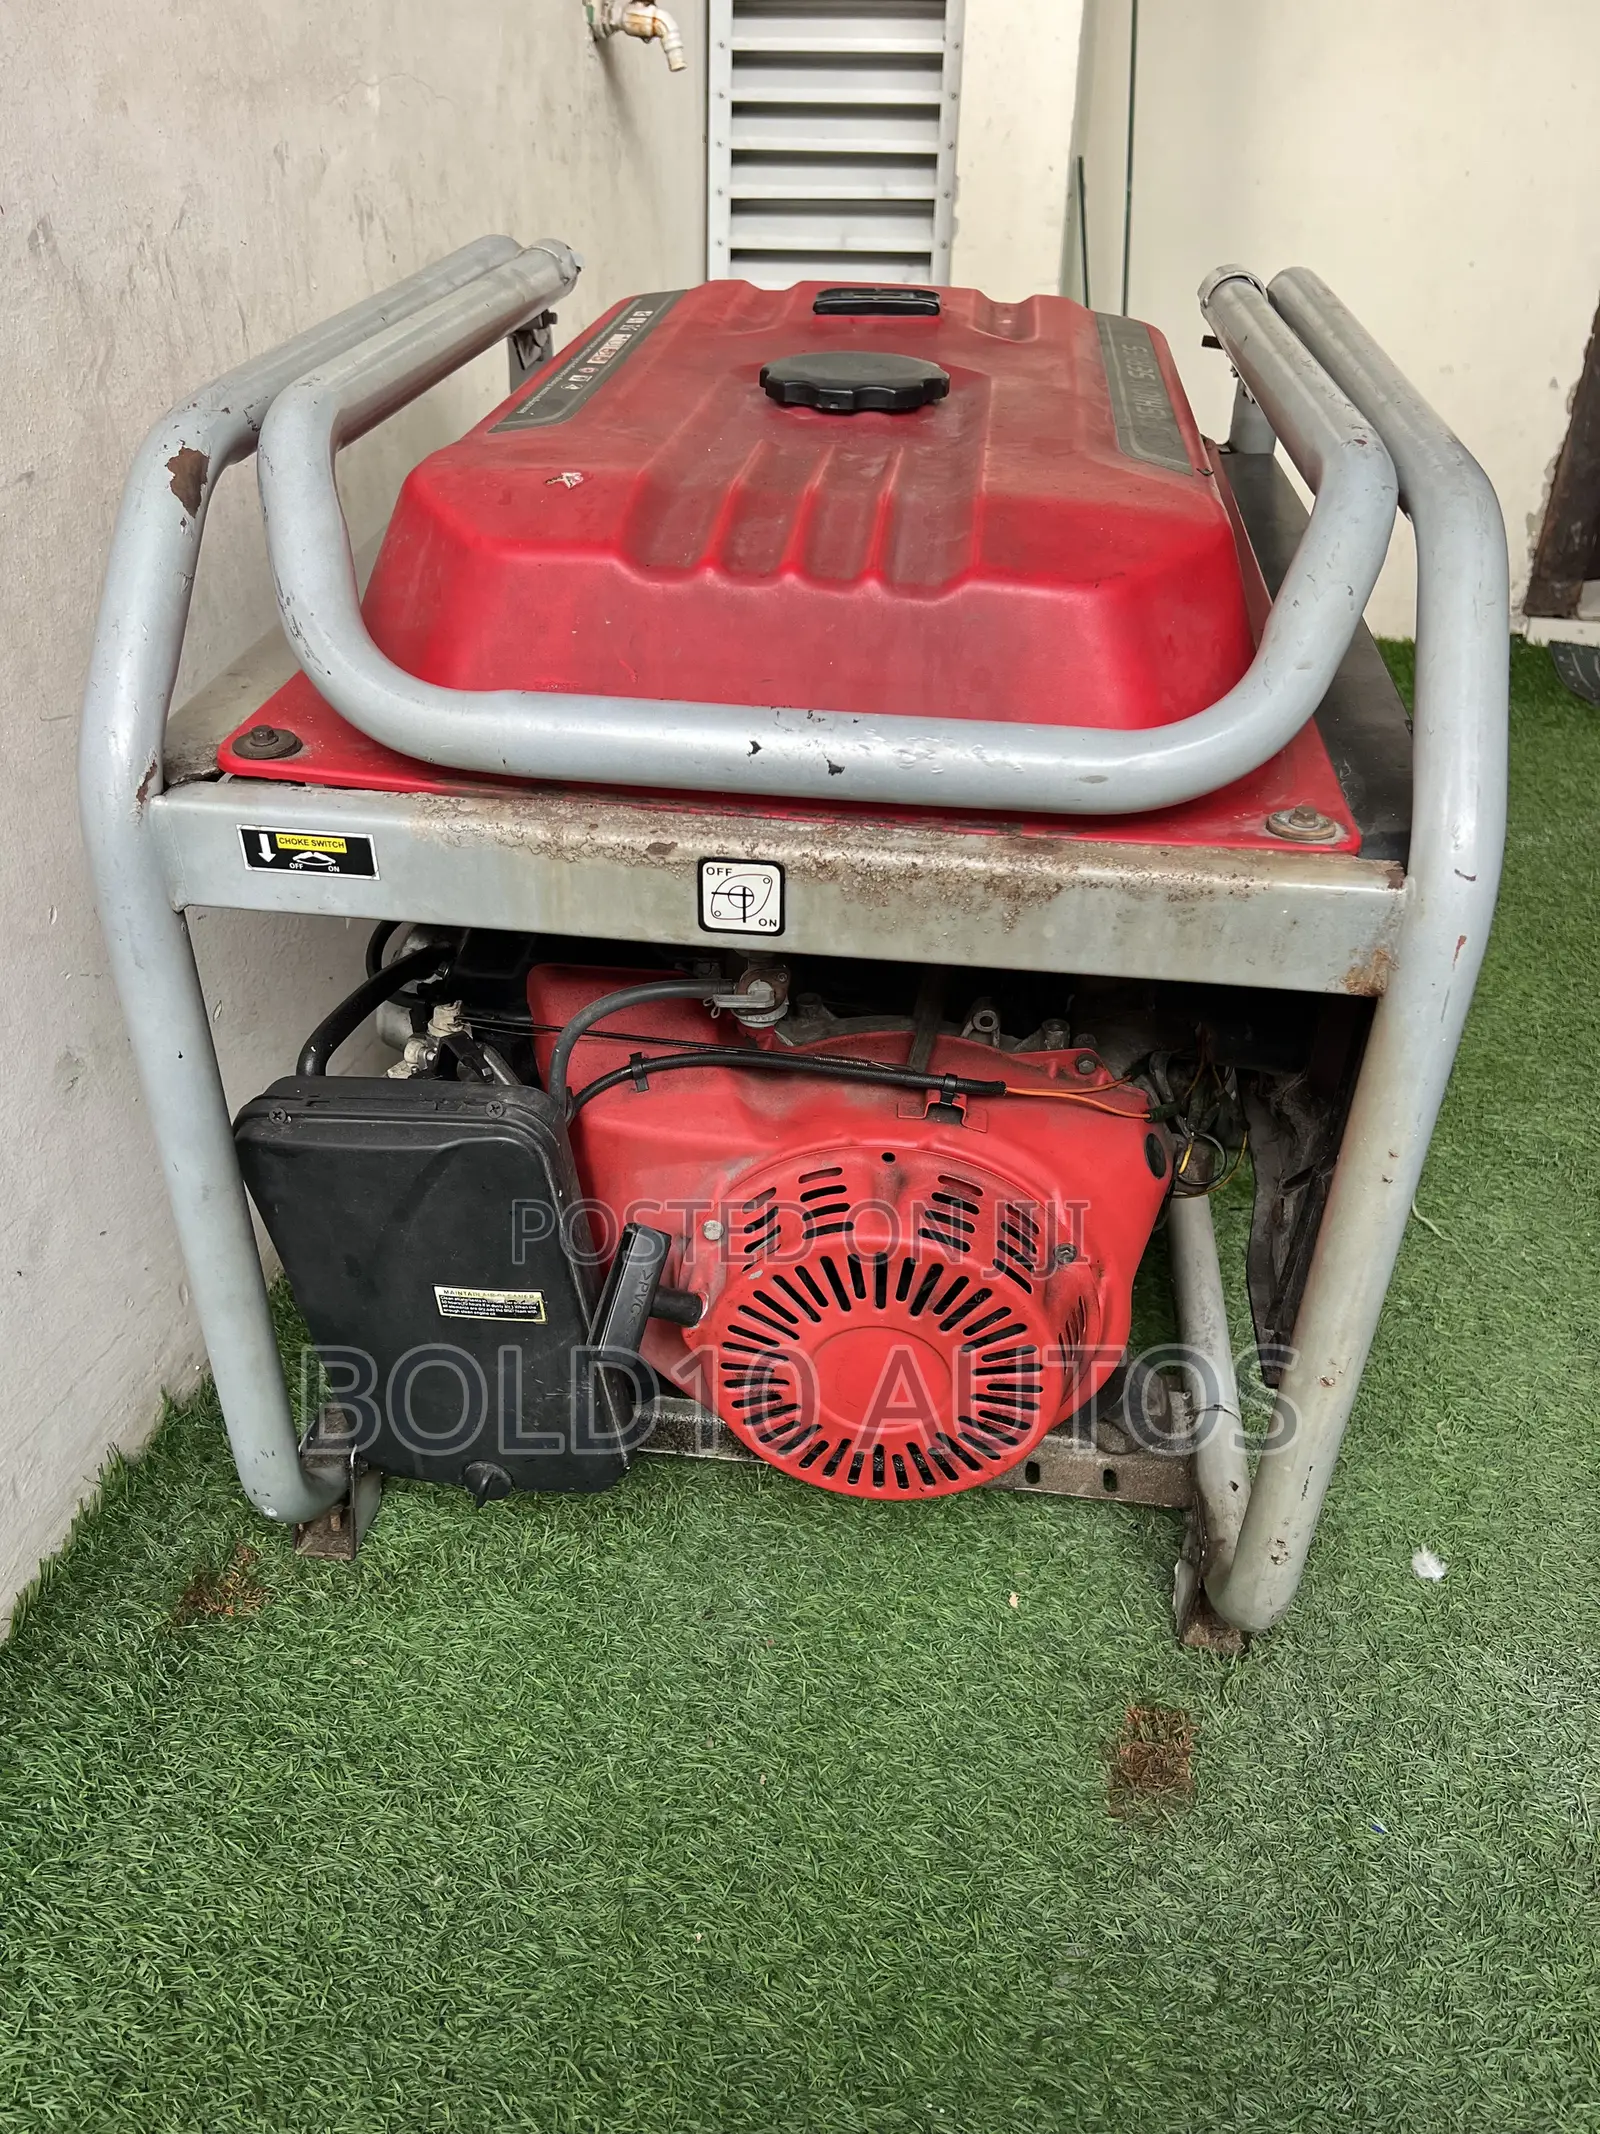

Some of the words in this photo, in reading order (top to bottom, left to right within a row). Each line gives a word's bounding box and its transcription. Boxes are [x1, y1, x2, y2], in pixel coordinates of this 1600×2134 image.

[1121, 344, 1156, 380] SERES
[278, 837, 310, 846] CHOKE
[311, 840, 345, 849] SWITCH
[706, 867, 732, 876] OFF
[758, 918, 777, 927] ON
